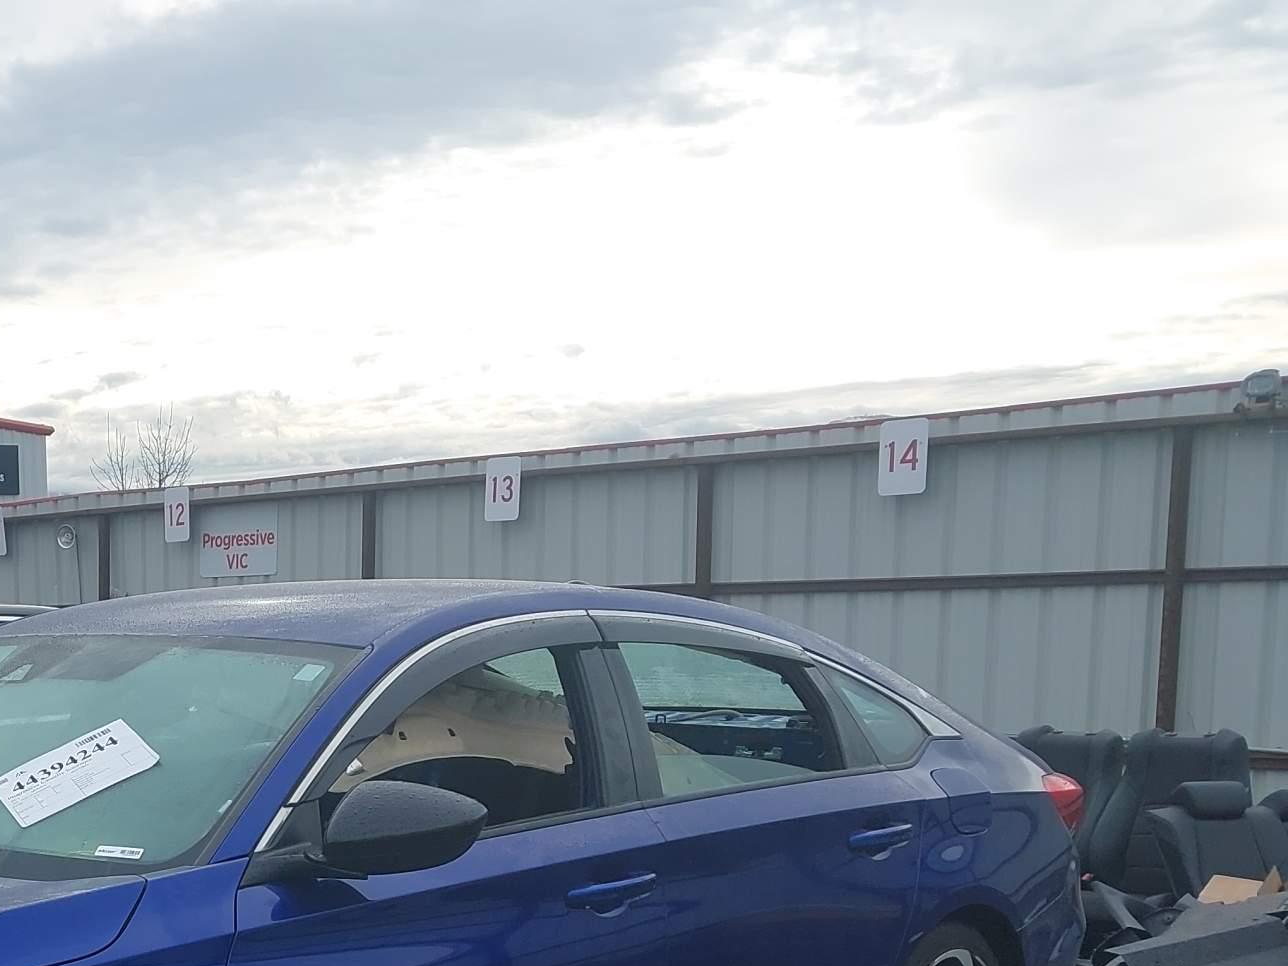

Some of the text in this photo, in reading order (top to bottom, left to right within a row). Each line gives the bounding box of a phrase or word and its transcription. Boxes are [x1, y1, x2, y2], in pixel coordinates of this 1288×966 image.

[887, 438, 920, 474] 14
[492, 475, 514, 503] 13
[168, 502, 185, 527] 12
[202, 529, 274, 550] Progressive
[226, 553, 249, 569] VIC
[12, 735, 119, 793] 44394244
